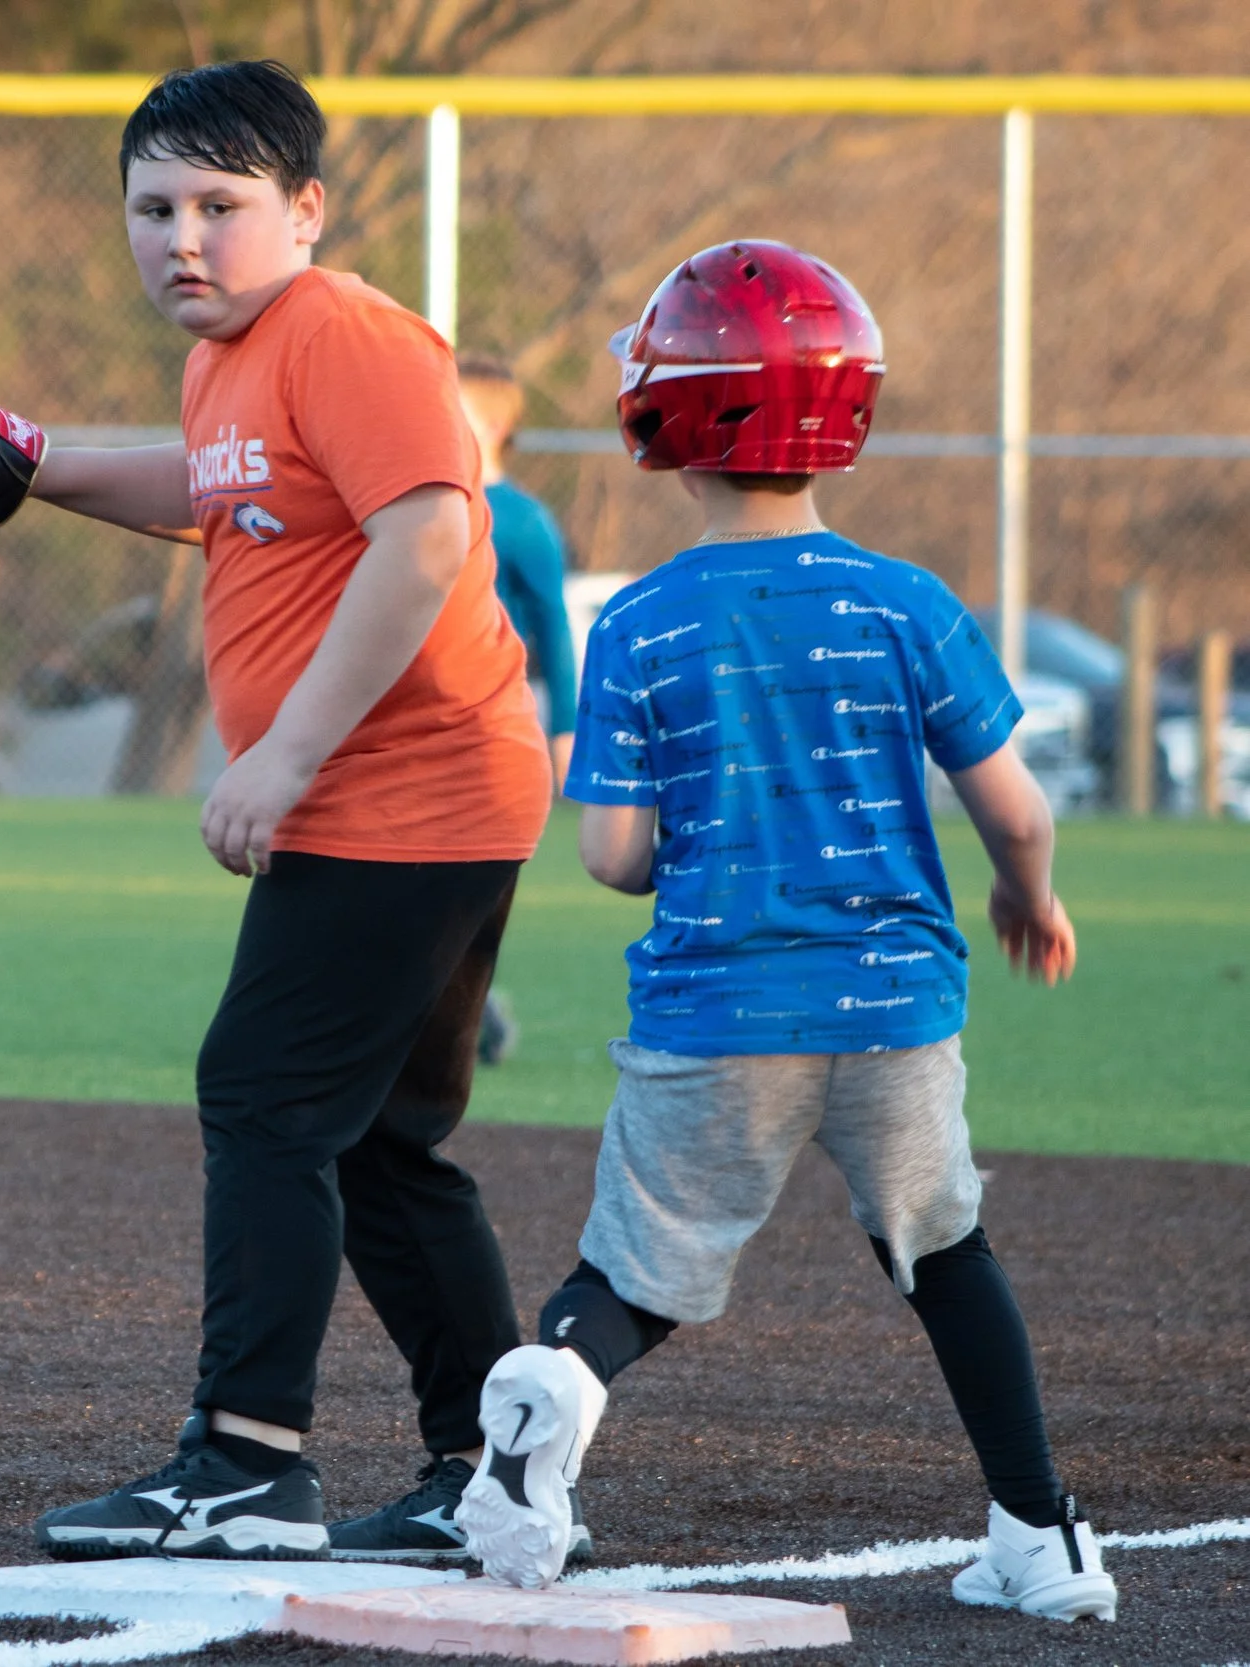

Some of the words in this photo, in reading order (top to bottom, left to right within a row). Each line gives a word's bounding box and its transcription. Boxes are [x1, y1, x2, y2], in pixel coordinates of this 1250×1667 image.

[797, 552, 875, 570] Champion
[808, 647, 887, 662] Champion
[833, 699, 907, 716] Champio
[811, 746, 880, 761] Champion
[820, 844, 888, 860] Champio
[859, 949, 935, 967] Champion
[836, 995, 915, 1012] Champion
